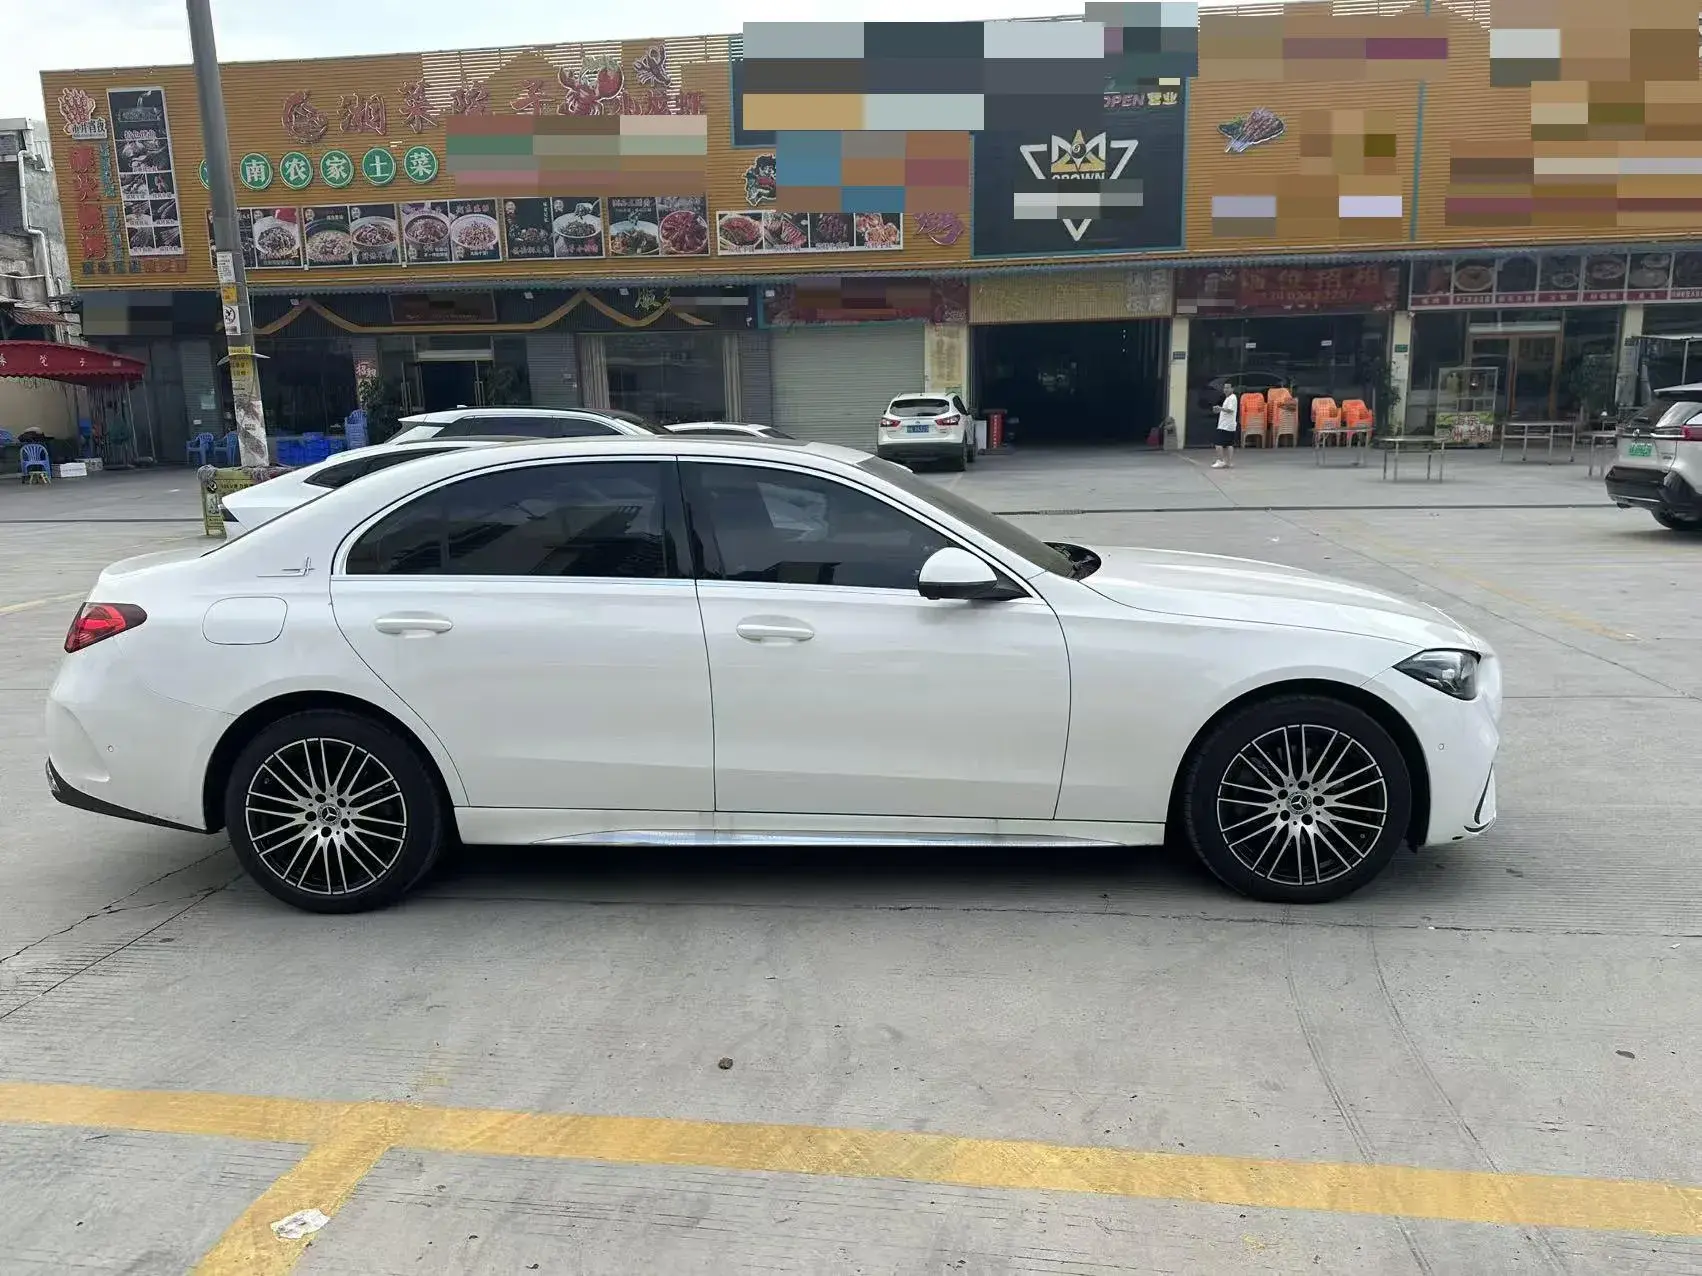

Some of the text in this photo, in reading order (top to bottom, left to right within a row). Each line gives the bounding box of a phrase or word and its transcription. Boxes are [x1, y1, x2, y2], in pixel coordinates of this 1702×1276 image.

[203, 151, 433, 184] 南农家土菜
